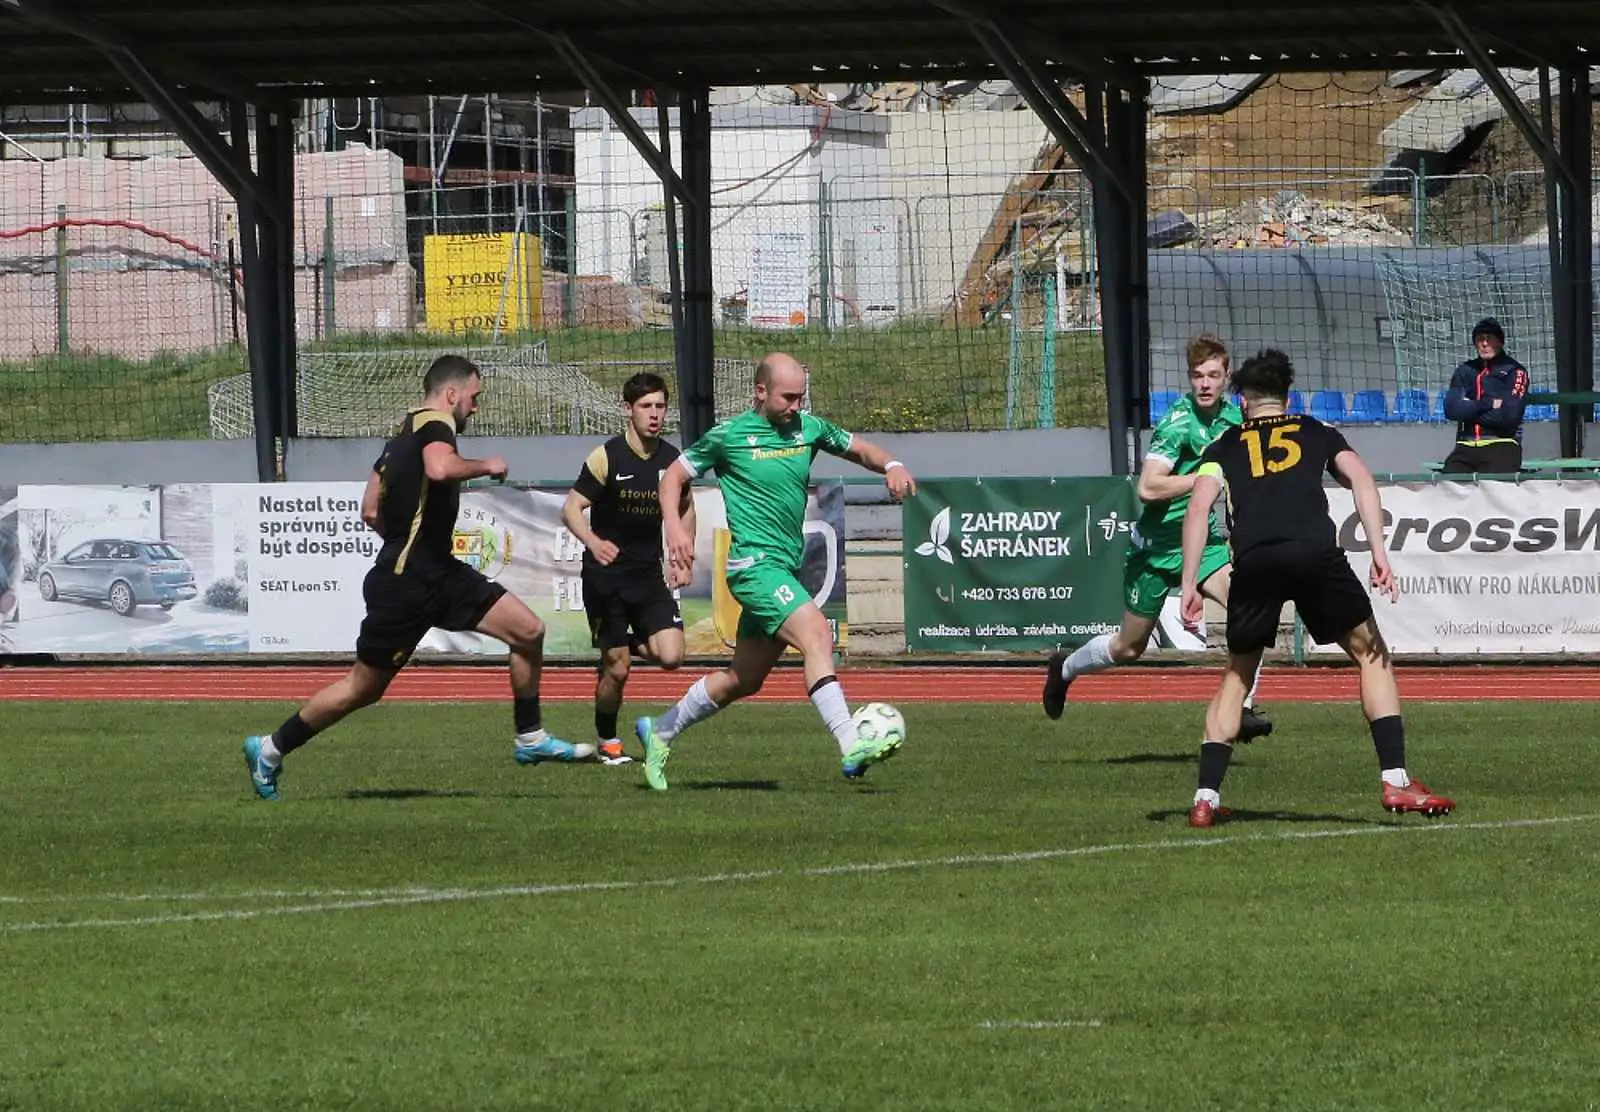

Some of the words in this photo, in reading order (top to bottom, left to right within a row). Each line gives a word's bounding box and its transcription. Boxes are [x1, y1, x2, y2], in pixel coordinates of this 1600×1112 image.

[446, 271, 507, 286] YTONG
[1240, 424, 1302, 478] 15
[259, 496, 323, 513] Nastal
[327, 497, 359, 512] ten
[259, 516, 338, 537] správný
[342, 516, 377, 533] ča
[961, 511, 1062, 532] ZAHRADY
[260, 537, 292, 558] být
[296, 537, 378, 558] dospělý.
[960, 533, 1071, 558] ŠAFRÁNEK
[260, 581, 288, 592] SEAT
[292, 581, 321, 592] Leon
[323, 581, 341, 592] ST.
[961, 587, 994, 600] +420
[996, 587, 1020, 600] 733
[1022, 586, 1047, 600] 676
[1049, 586, 1073, 599] 107
[1479, 575, 1511, 594] PRO
[774, 584, 796, 606] 13
[919, 623, 970, 637] realizace
[1070, 620, 1121, 634] osvětlen
[1497, 620, 1553, 635] dovozce
